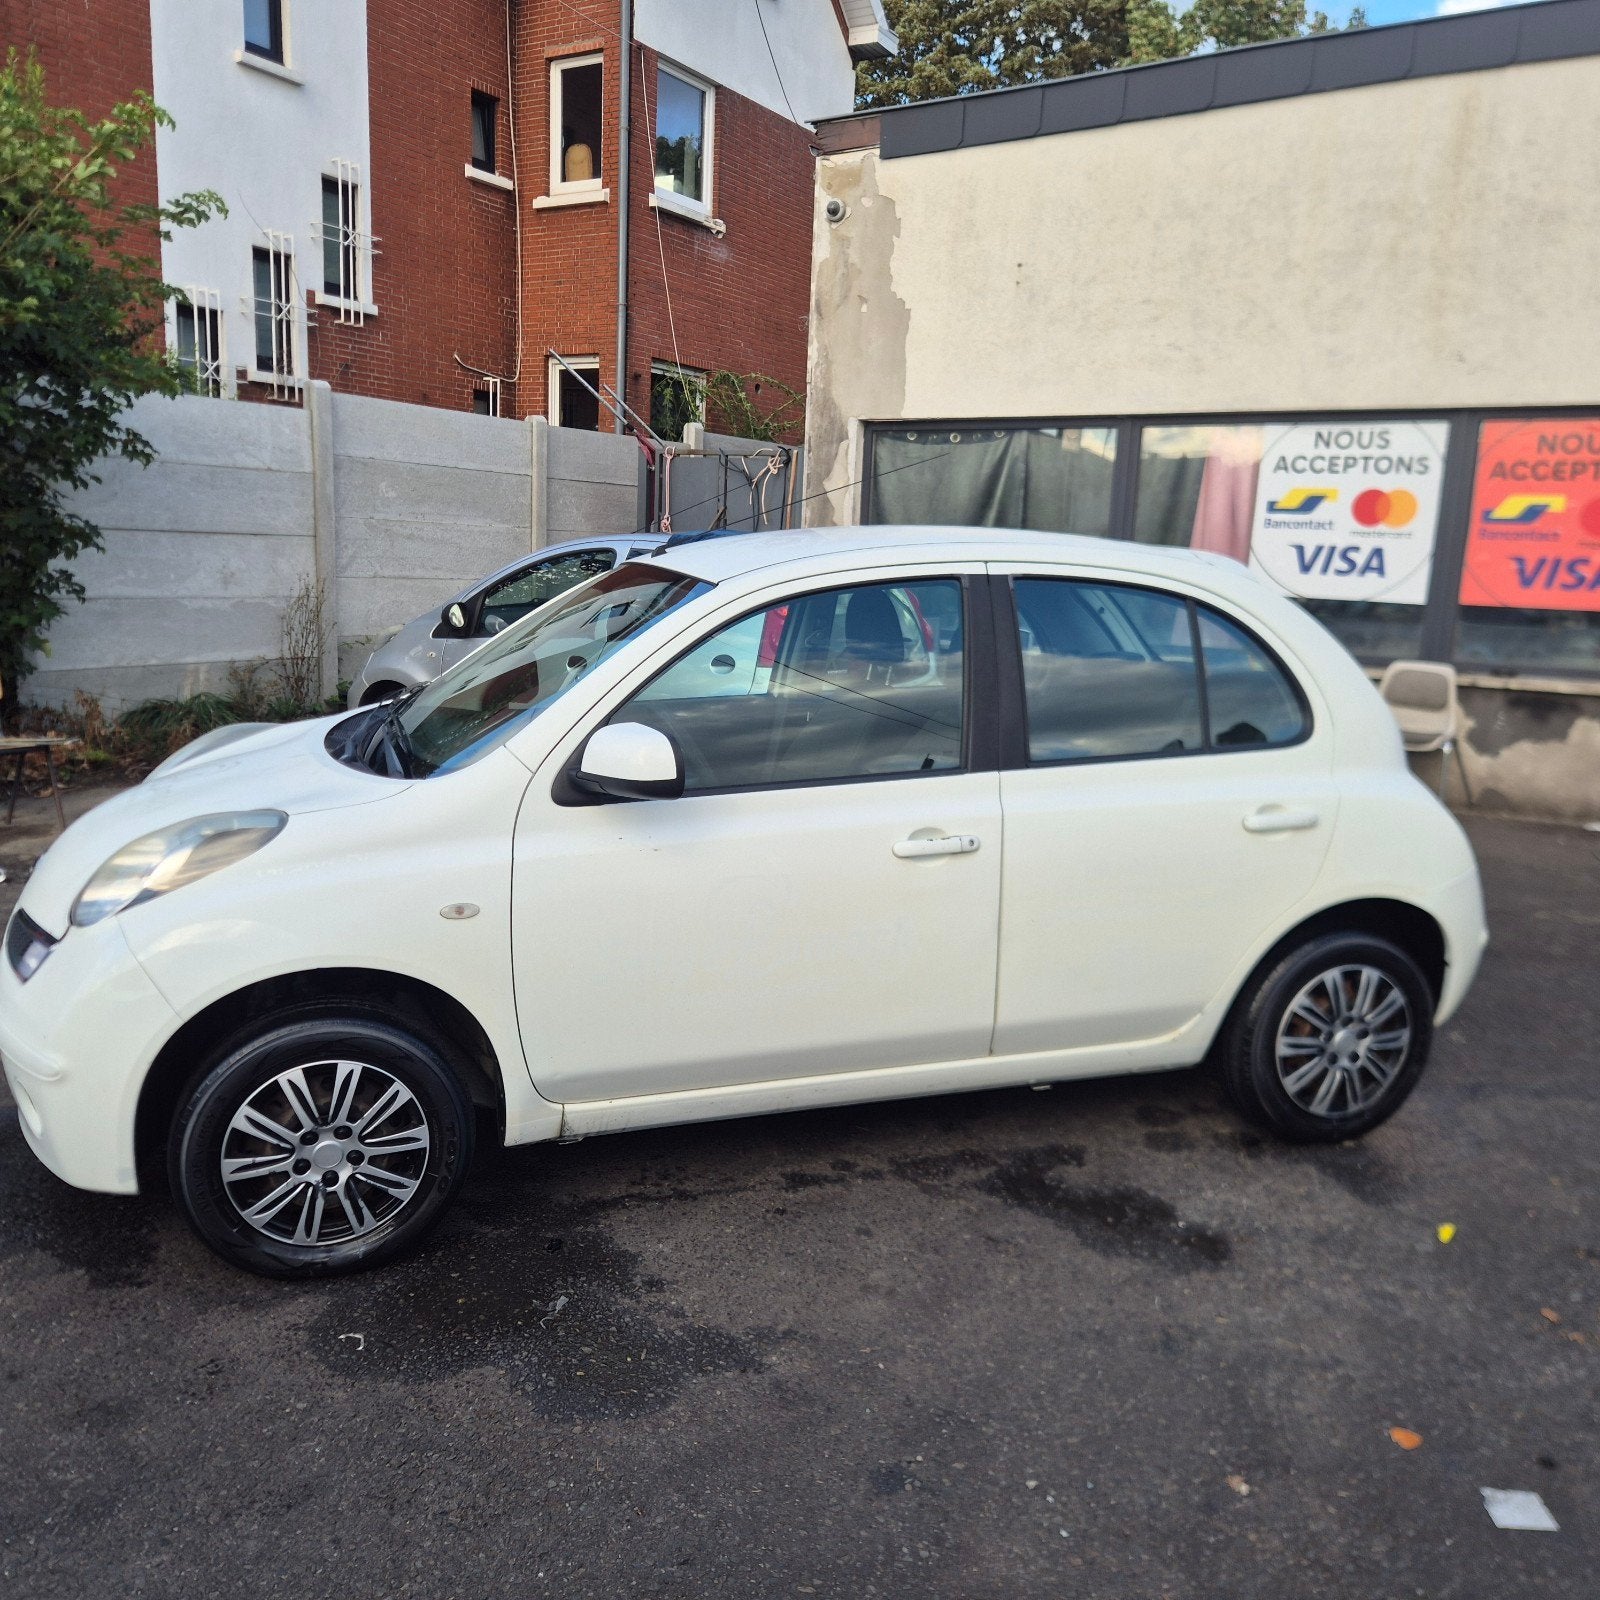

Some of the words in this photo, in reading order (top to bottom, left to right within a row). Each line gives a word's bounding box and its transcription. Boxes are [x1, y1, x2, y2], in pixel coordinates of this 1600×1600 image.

[1313, 430, 1390, 450] NOUS
[1273, 455, 1430, 475] ACCEPTONS
[1264, 517, 1334, 532] Bancontact
[1289, 544, 1386, 578] VISA
